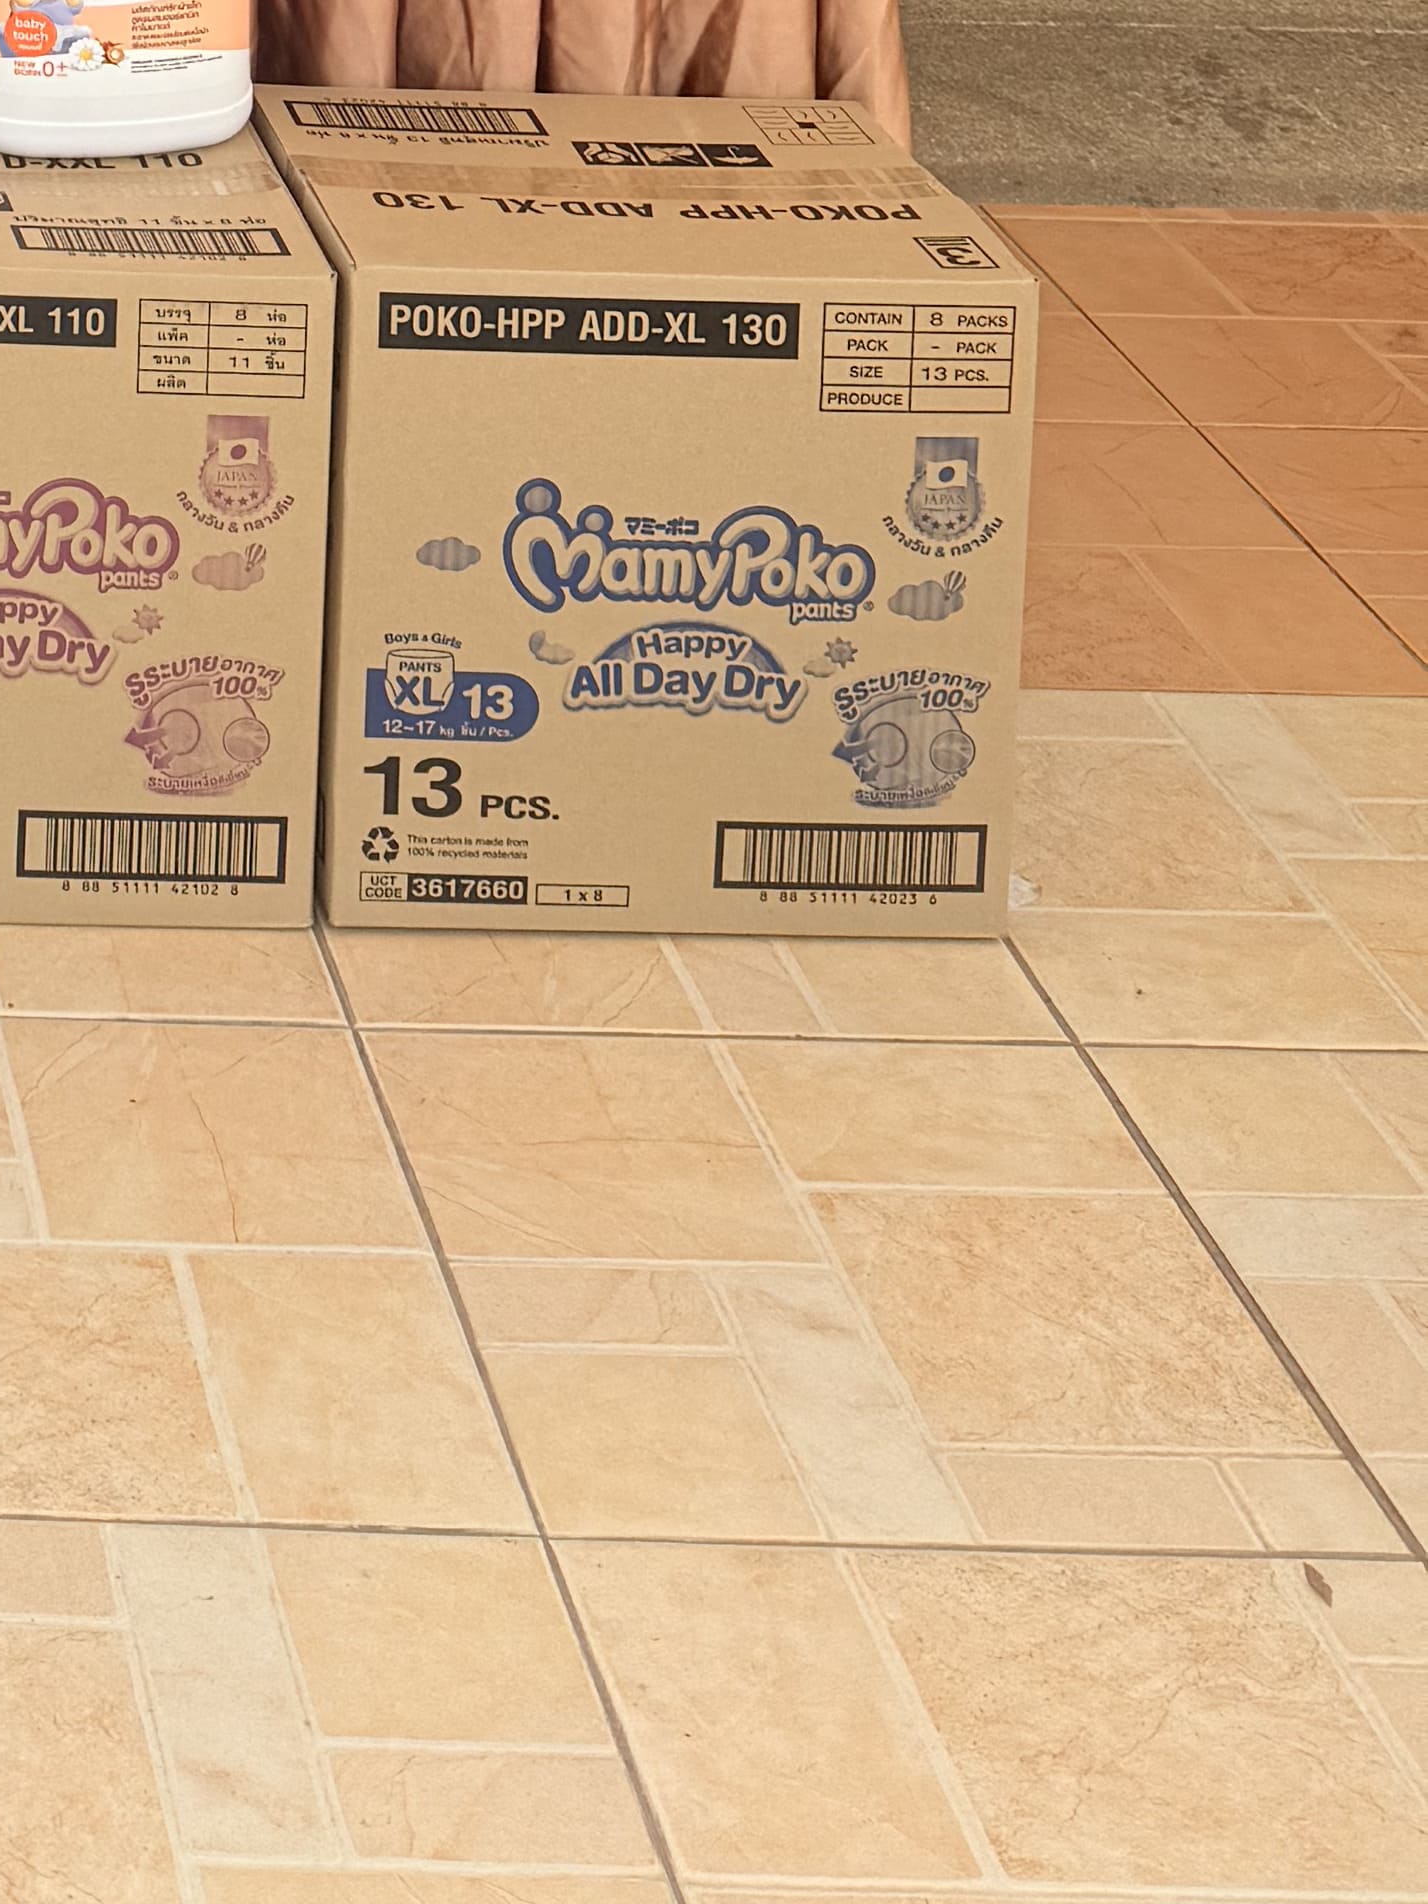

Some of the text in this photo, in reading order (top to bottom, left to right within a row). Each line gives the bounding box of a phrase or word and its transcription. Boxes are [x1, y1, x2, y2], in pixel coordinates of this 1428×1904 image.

[48, 306, 105, 336] 110
[389, 303, 787, 346] POKO-HPP ADD-XL 130
[834, 311, 903, 327] CONTAIN
[502, 478, 876, 613] MamyPoko
[393, 675, 445, 707] XL
[480, 794, 560, 821] PCS.
[410, 877, 524, 901] 3617660
